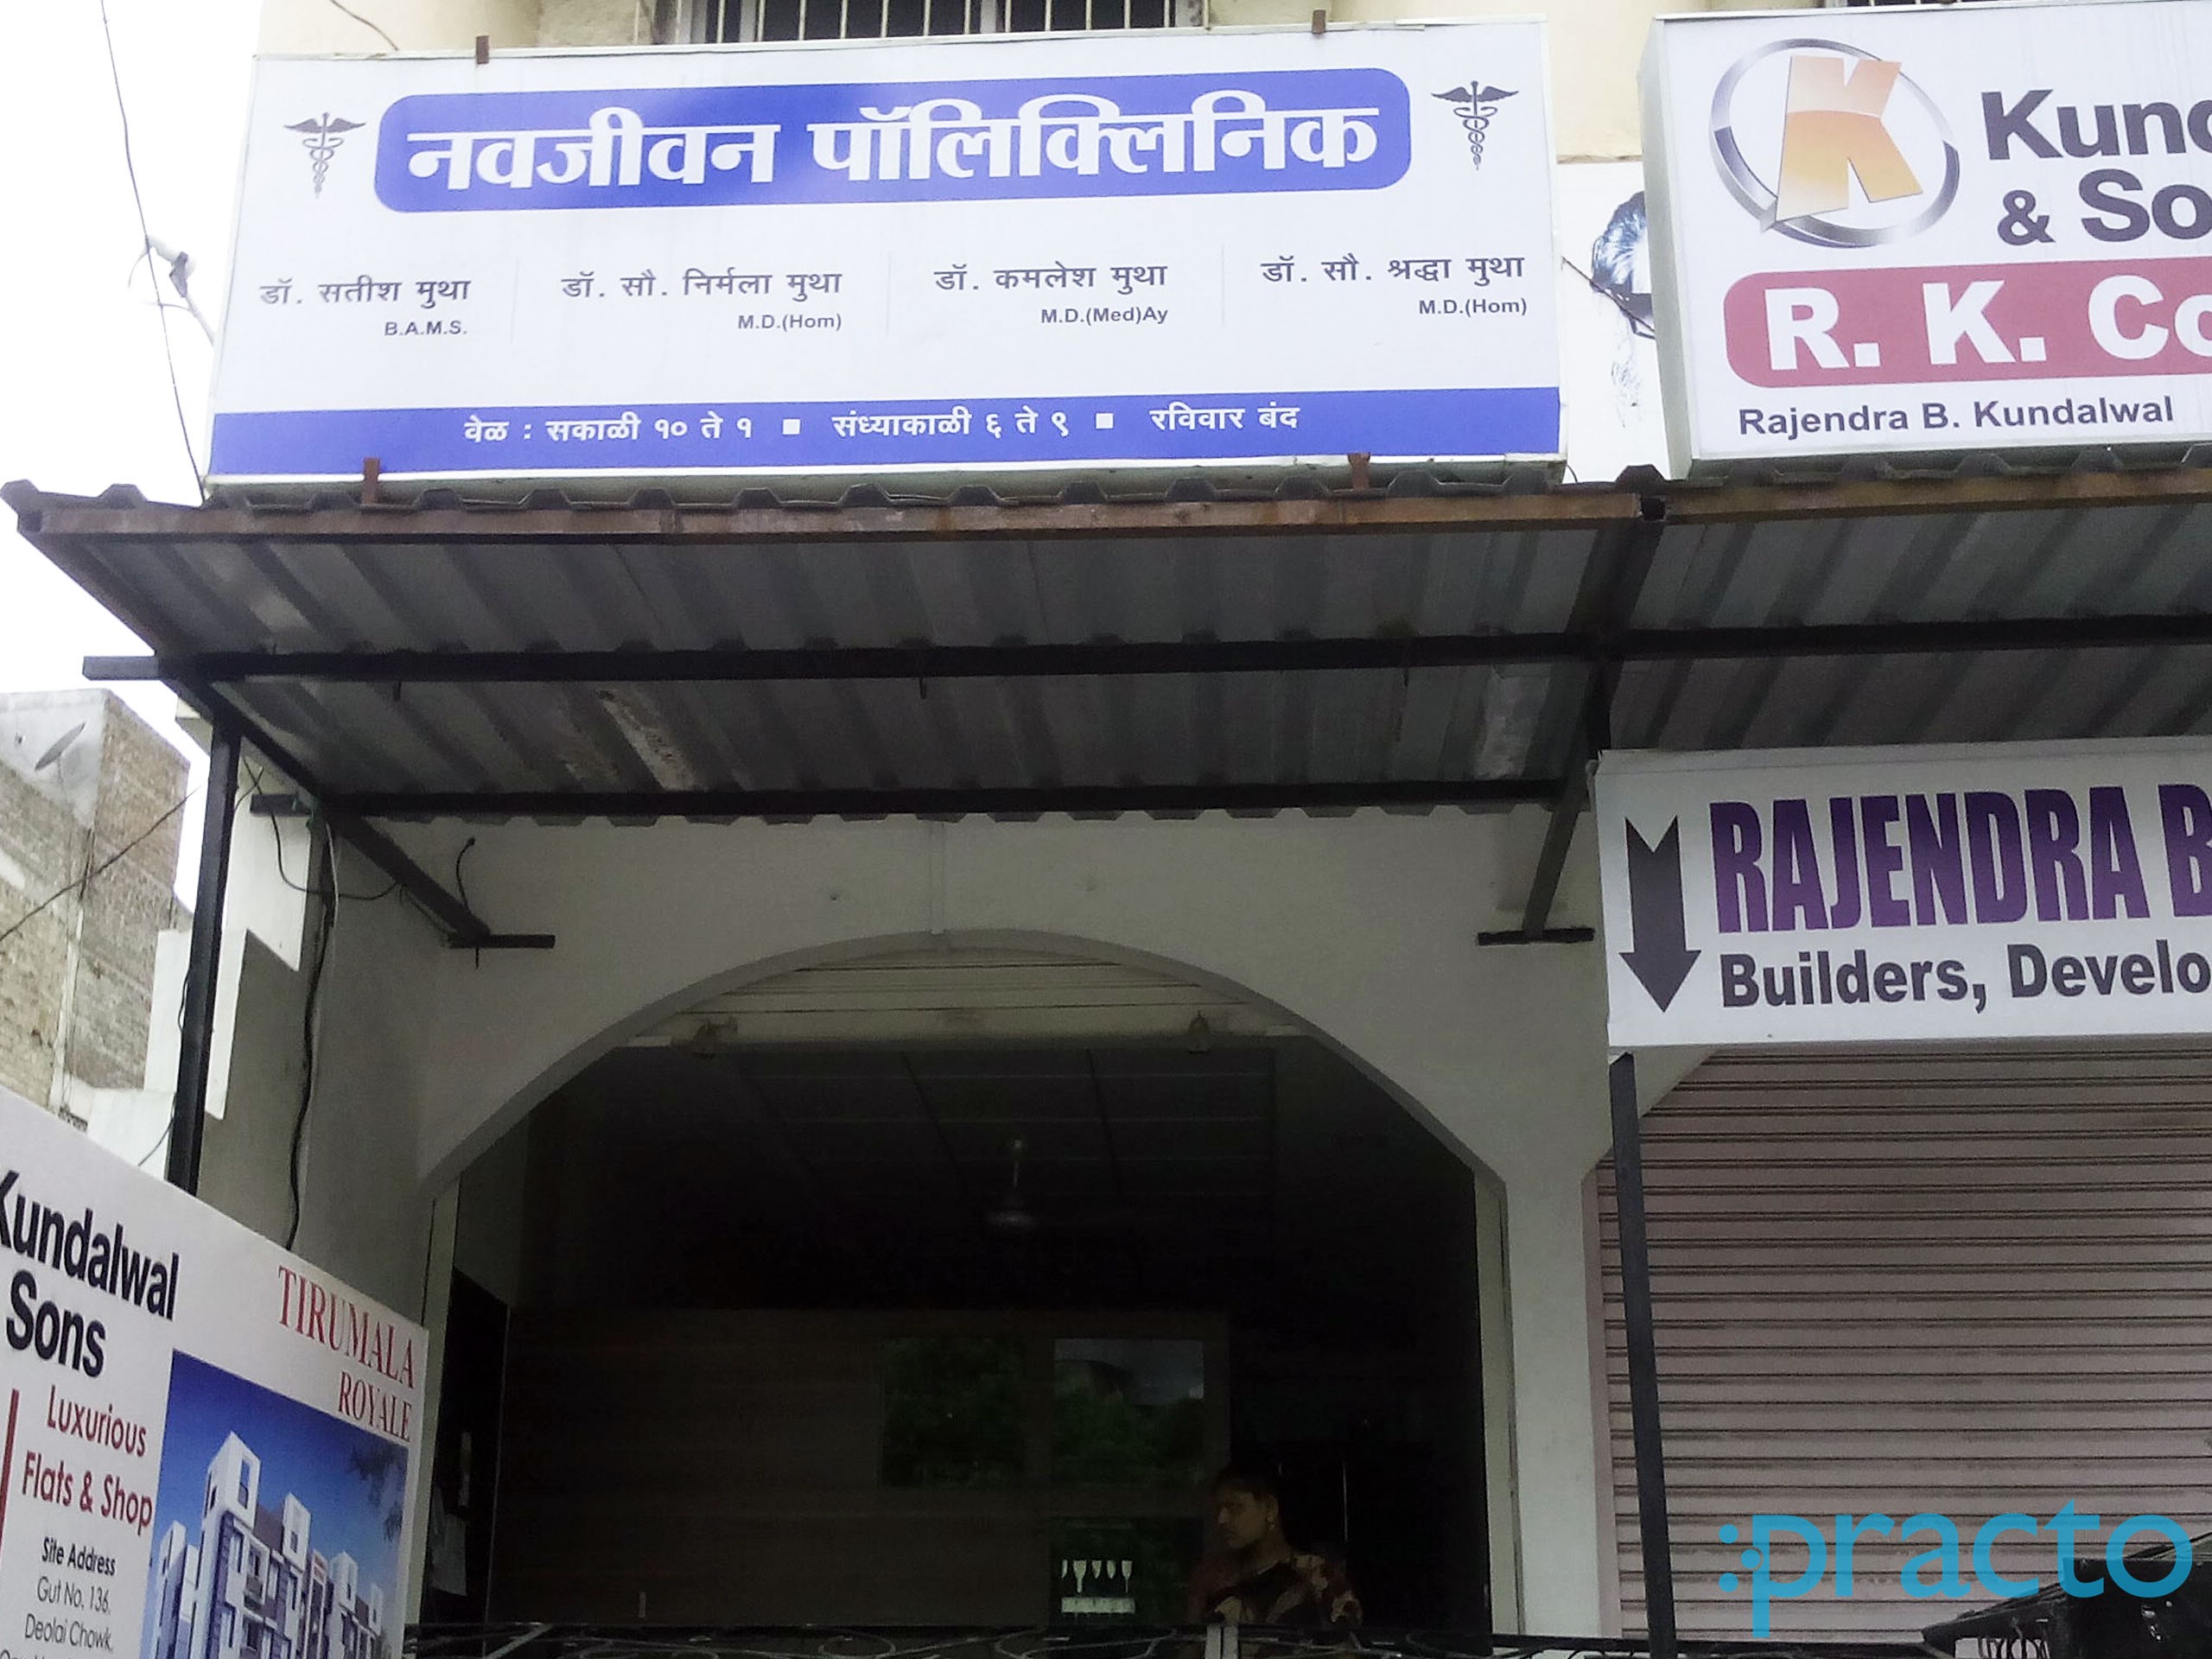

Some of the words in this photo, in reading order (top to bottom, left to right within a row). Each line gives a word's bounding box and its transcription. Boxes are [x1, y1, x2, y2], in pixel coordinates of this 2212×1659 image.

[408, 107, 781, 190] नवजीवन
[807, 89, 1380, 181] पॉलिक्लिनिक
[1997, 189, 2056, 246] &
[560, 270, 605, 298] डॉ.
[620, 269, 668, 297] सौ.
[682, 267, 773, 296] निर्मला
[786, 273, 843, 302] मुथा
[933, 264, 979, 290] डॉ.
[994, 260, 1097, 289] कमलेश
[1109, 265, 1168, 296] मुथा
[1260, 255, 1307, 283] डॉ.
[1321, 252, 1372, 282] सौ.
[1387, 258, 1452, 282] श्रद्धा
[1465, 257, 1525, 287] मुथा
[259, 277, 302, 305] डॉ.
[318, 275, 403, 303] सतीश
[416, 280, 472, 309] मुथा
[1419, 297, 1527, 318] M.D.(Hom)
[385, 320, 468, 336] B.A.M.S.
[738, 313, 842, 333] M.D.(Hom)
[1041, 306, 1168, 327] M.D.(Med)Ay
[1764, 287, 1881, 371] R.
[1923, 280, 2047, 365] K.
[463, 415, 510, 443] वेळ
[544, 410, 642, 442] सकाळी
[654, 418, 688, 440] १०
[699, 410, 724, 439] ते
[831, 406, 973, 437] संध्याकाळी
[986, 413, 1002, 439] ६
[1014, 405, 1039, 434] ते
[1148, 401, 1246, 430] रविवार
[1256, 401, 1301, 429] बंद
[1738, 404, 1909, 441] Rajendra
[1922, 403, 1960, 429] B.
[1974, 395, 2174, 428] Kundalwal
[1708, 785, 2151, 933] RAJENDRA
[1719, 949, 1986, 1014] Builders,
[2006, 938, 2212, 998] Develo
[6, 1268, 106, 1377] Sons
[278, 1264, 416, 1389] TIRUMALA
[47, 1383, 147, 1458] Luxurious
[338, 1370, 412, 1442] ROYALE
[22, 1450, 74, 1507] Flats
[79, 1471, 93, 1513] &
[101, 1473, 153, 1536] Shop
[41, 1536, 65, 1565] Site
[67, 1542, 116, 1576] Address
[37, 1575, 61, 1604] Gut
[24, 1612, 68, 1643] Deolai
